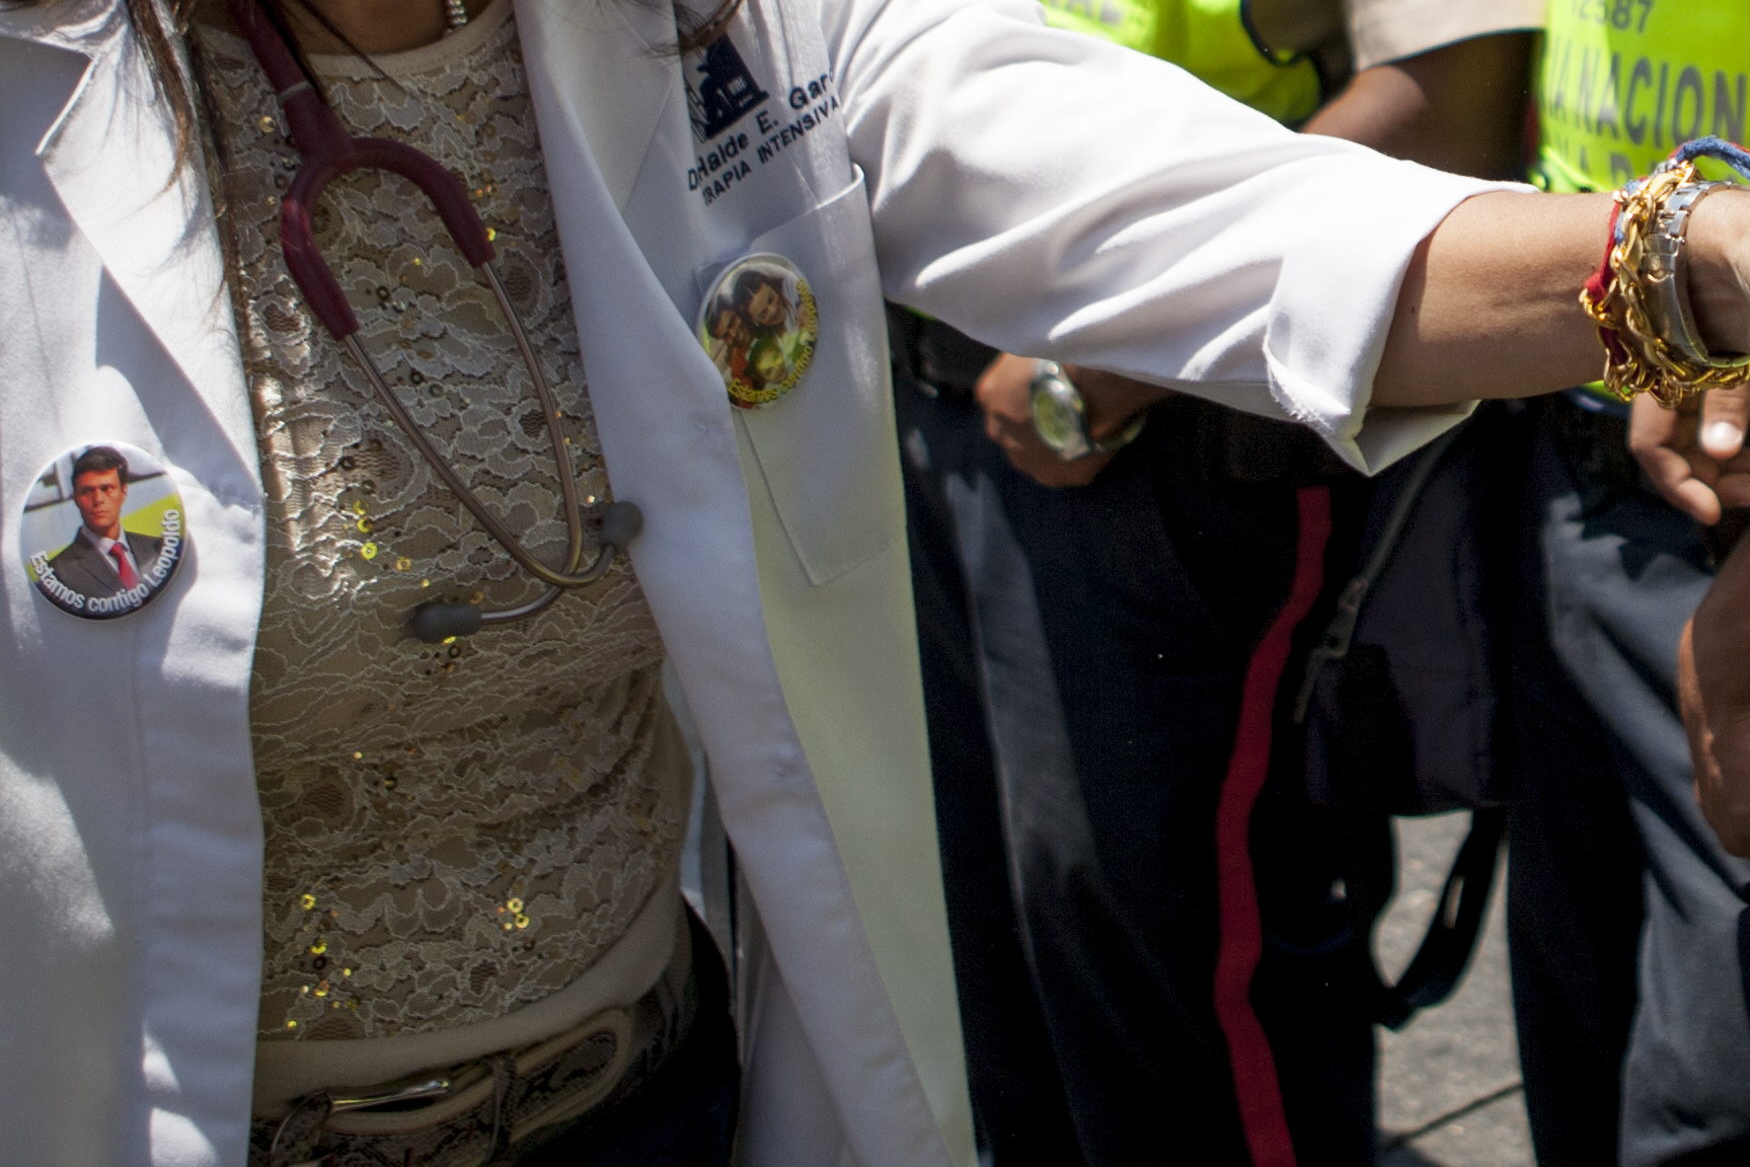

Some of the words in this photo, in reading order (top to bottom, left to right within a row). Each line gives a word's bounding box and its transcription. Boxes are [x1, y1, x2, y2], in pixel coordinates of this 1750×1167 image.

[789, 72, 834, 110] Gar
[701, 160, 753, 207] RAPIA
[756, 94, 840, 165] INTENSIVA
[30, 549, 86, 610] Estamos
[87, 583, 150, 613] contigo
[143, 509, 181, 588] Leopoldo
